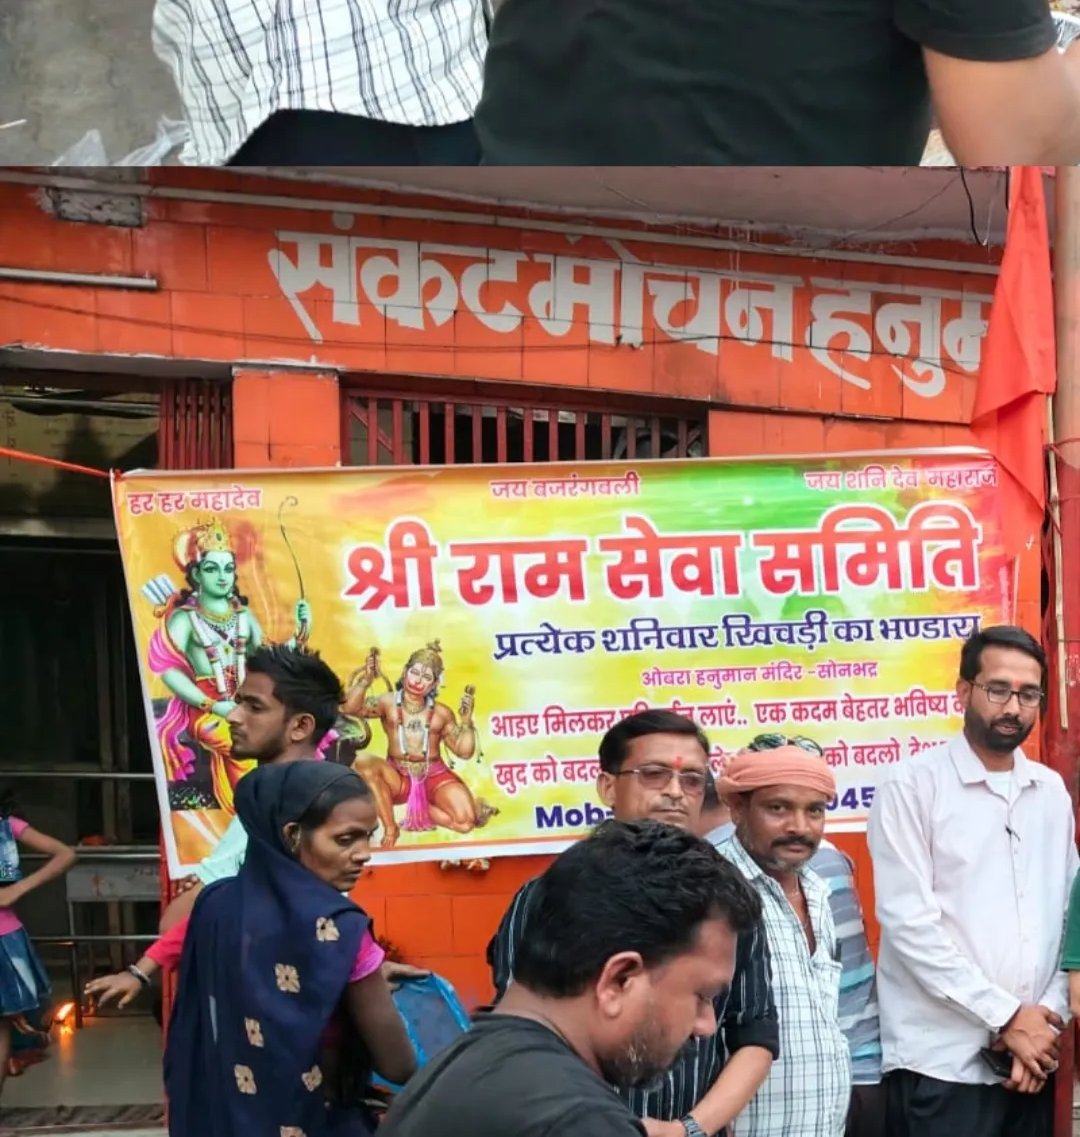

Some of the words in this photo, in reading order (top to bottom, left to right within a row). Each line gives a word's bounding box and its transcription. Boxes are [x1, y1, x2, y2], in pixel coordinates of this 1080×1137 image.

[490, 480, 528, 498] जय
[533, 471, 640, 498] बजरंगबली
[804, 471, 841, 490] जय
[846, 465, 887, 489] शनि
[892, 465, 918, 488] देव
[127, 493, 154, 514] हर
[158, 492, 186, 513] हर
[191, 485, 262, 511] महादेव
[344, 520, 439, 611] श्री
[450, 540, 588, 606] राम
[599, 516, 742, 599] सेवा
[753, 503, 980, 594] समिति
[493, 622, 596, 660] प्रत्येक
[601, 617, 719, 652] शनिवार
[722, 610, 828, 651] खिचड़ी
[833, 619, 875, 641] का
[880, 615, 981, 641] भण्डारा
[642, 667, 691, 686] ओबरा
[695, 666, 757, 689] हनुमान
[762, 662, 803, 682] मंदिर
[492, 713, 540, 738] आइए
[543, 705, 616, 735] मिलकर
[754, 702, 787, 724] एक
[790, 699, 837, 722] कदम
[841, 693, 889, 721] बेहतर
[894, 689, 948, 717] भविष्य
[494, 764, 527, 793] खुद
[531, 755, 558, 783] को
[561, 759, 601, 782] बदल
[824, 739, 848, 767] को
